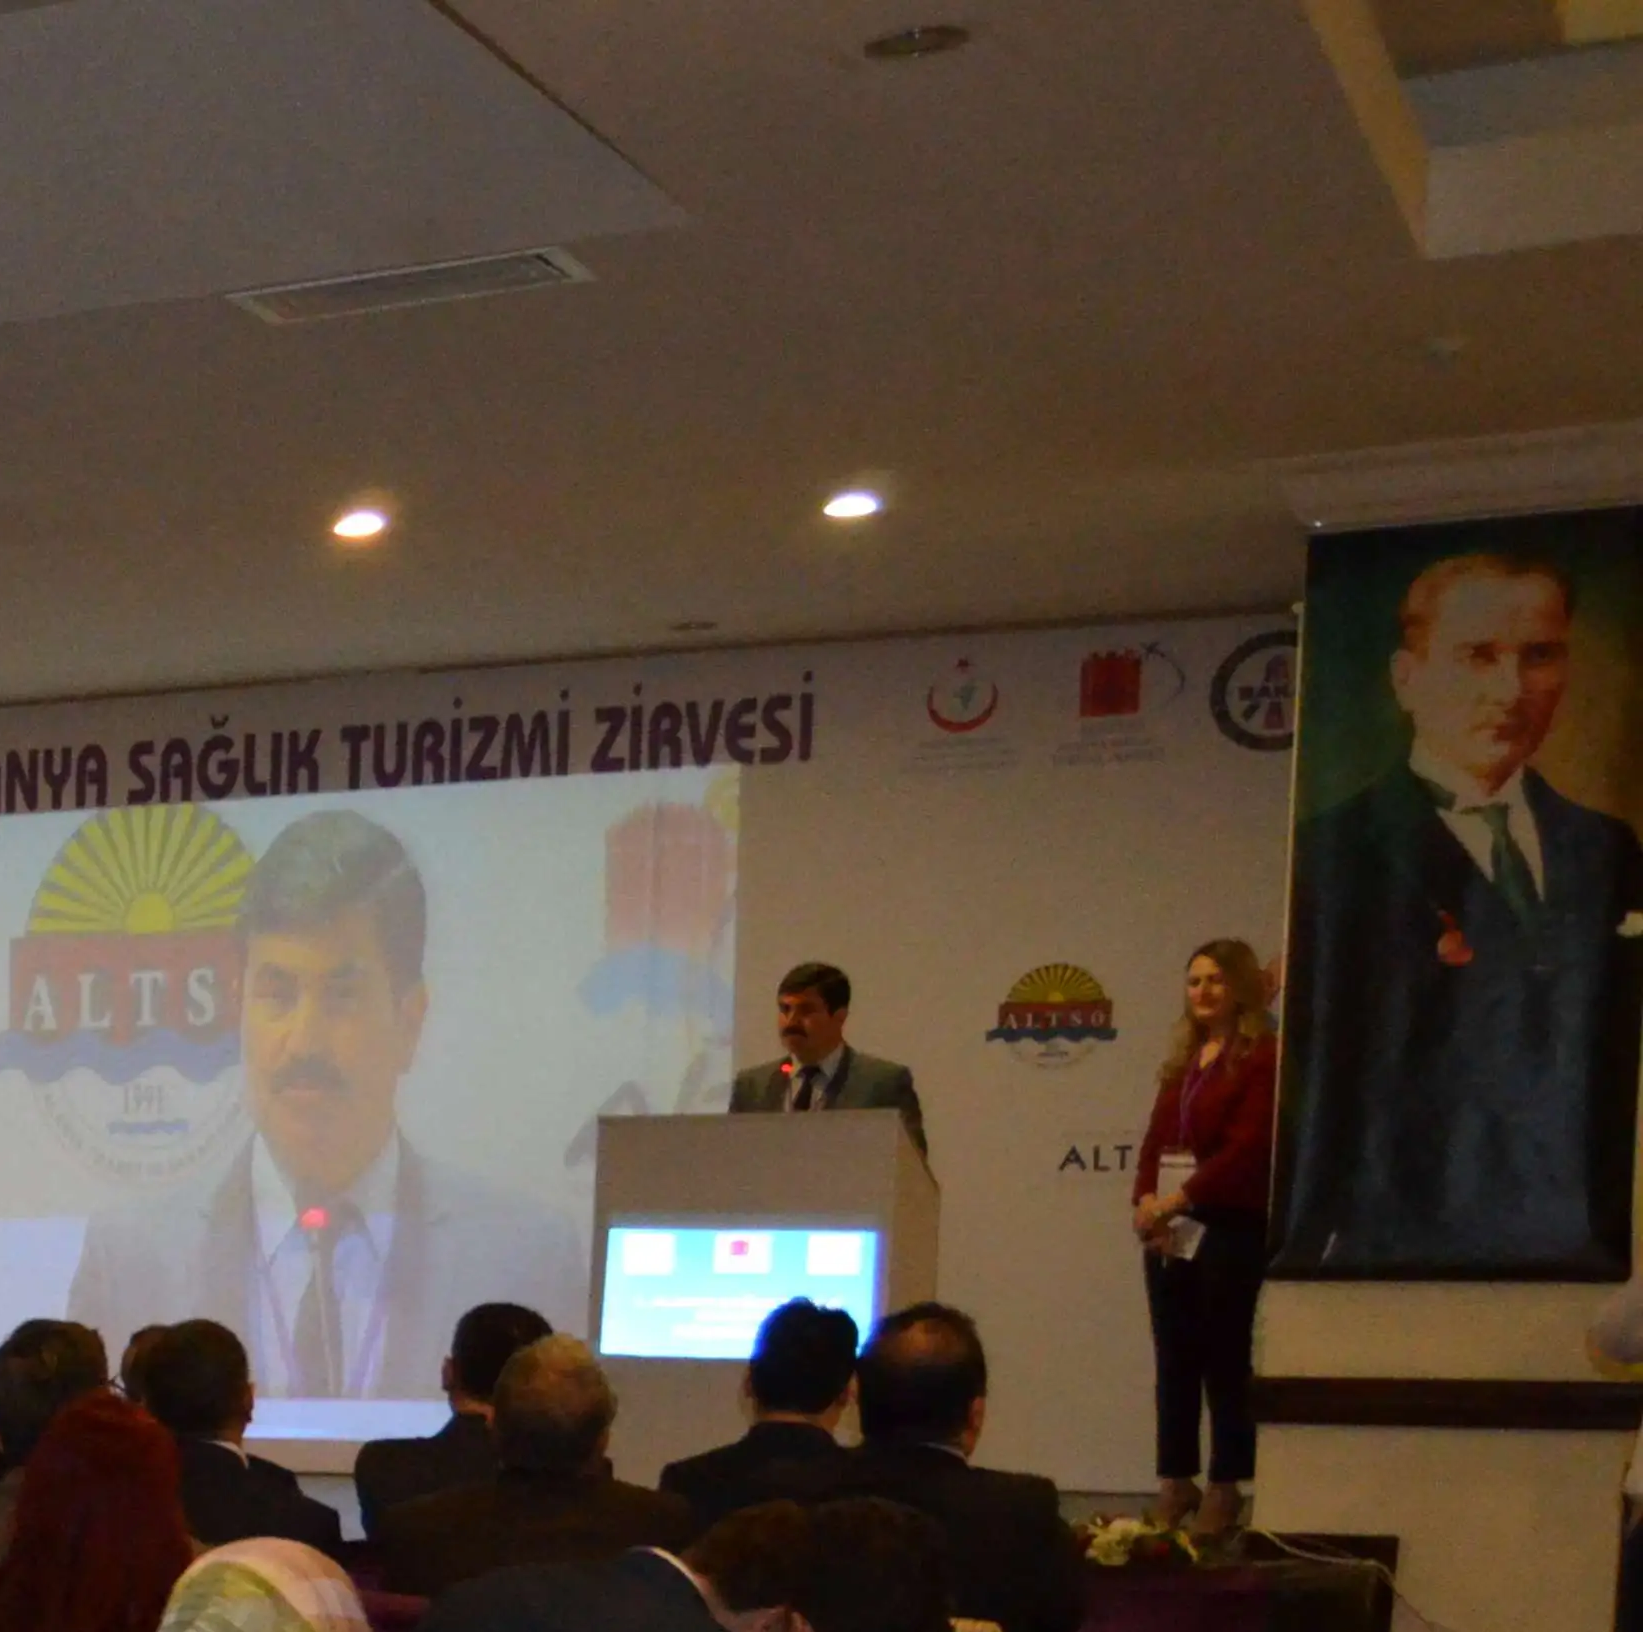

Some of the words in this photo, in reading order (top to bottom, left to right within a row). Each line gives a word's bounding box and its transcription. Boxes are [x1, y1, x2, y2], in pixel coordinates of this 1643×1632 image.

[1237, 685, 1295, 702] BAK
[126, 714, 323, 802] SAĞLIK
[340, 688, 571, 790] TURİZMİ
[590, 669, 814, 772] ZİRVESİ
[22, 967, 240, 1031] ALTS
[1058, 1145, 1138, 1172] ALT
